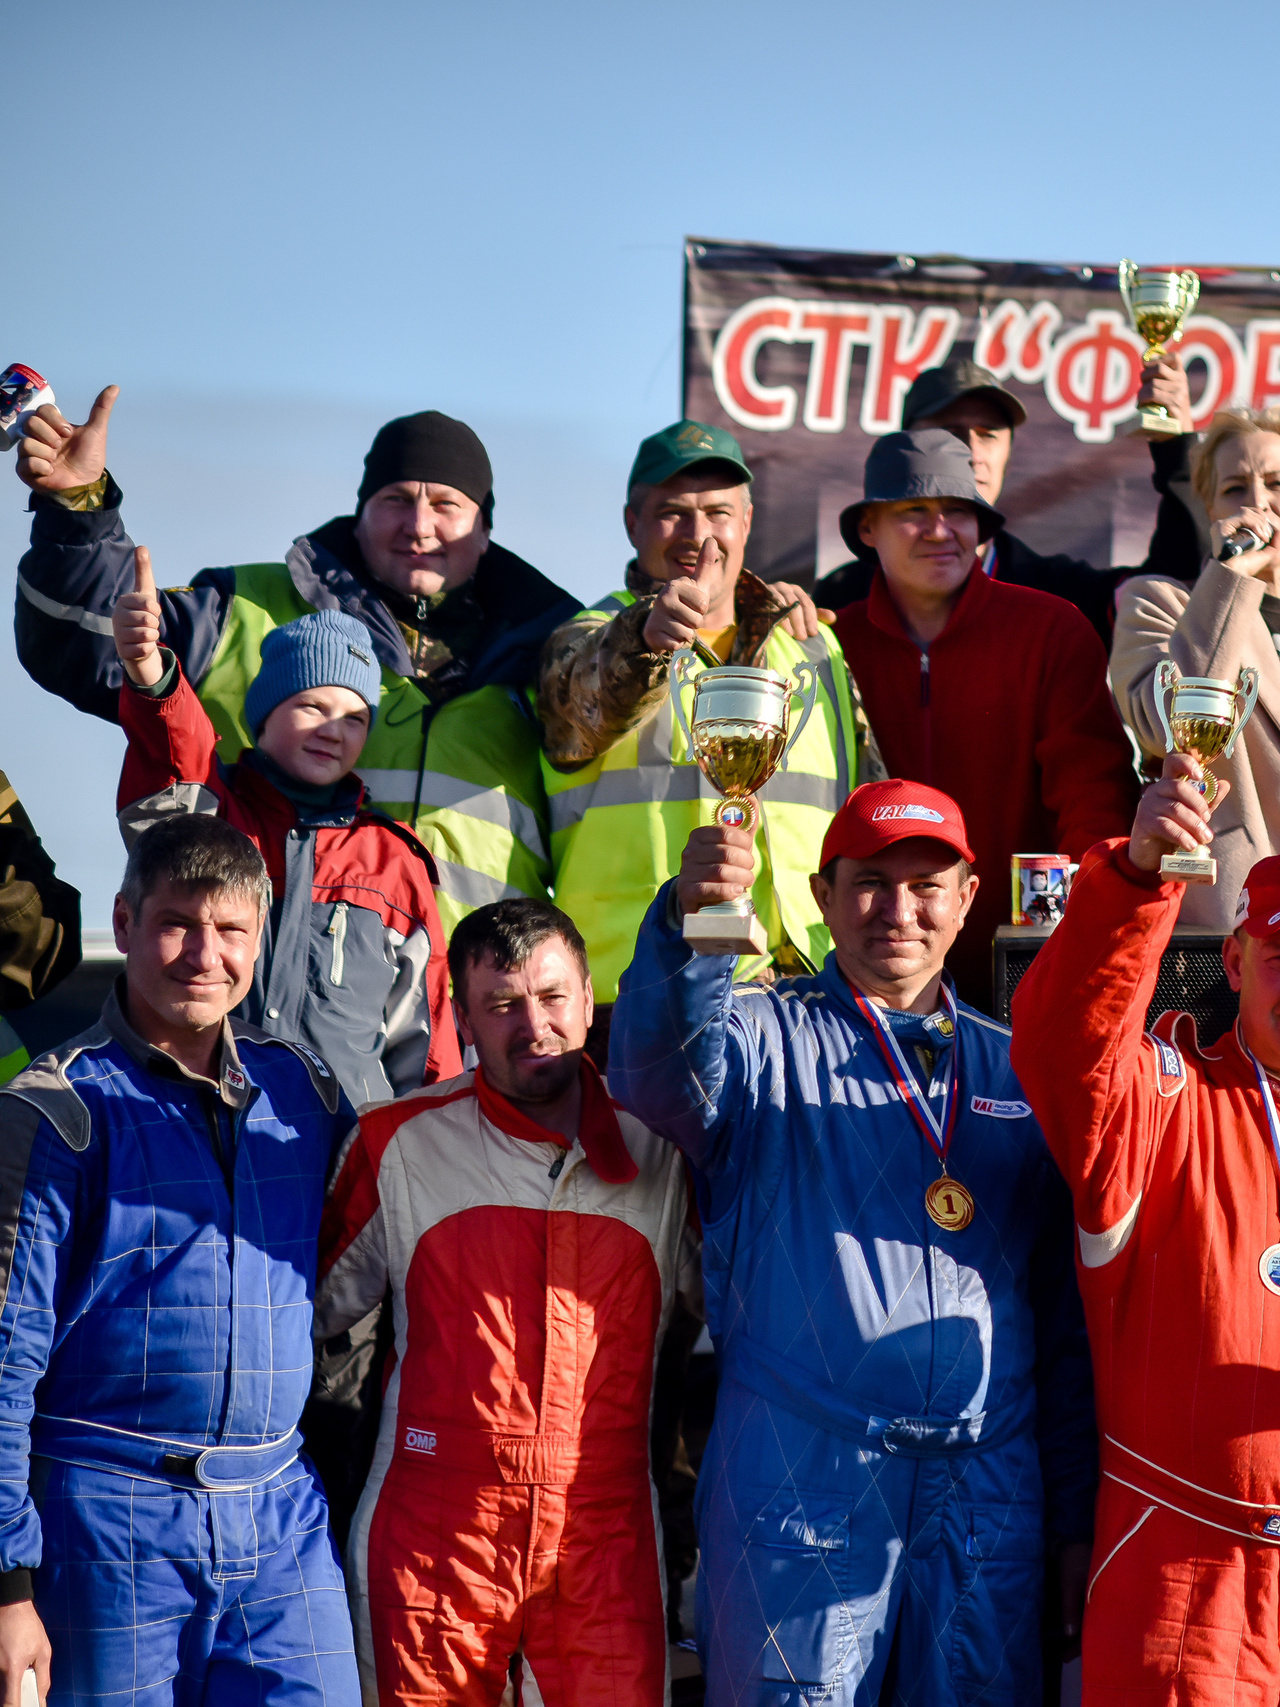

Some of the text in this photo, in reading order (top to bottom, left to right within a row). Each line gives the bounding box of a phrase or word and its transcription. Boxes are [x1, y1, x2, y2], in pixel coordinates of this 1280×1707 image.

[713, 297, 960, 436] СТК
[873, 805, 906, 821] VAL
[974, 1099, 993, 1112] VAL
[942, 1193, 958, 1215] 1
[405, 1431, 437, 1450] OMP
